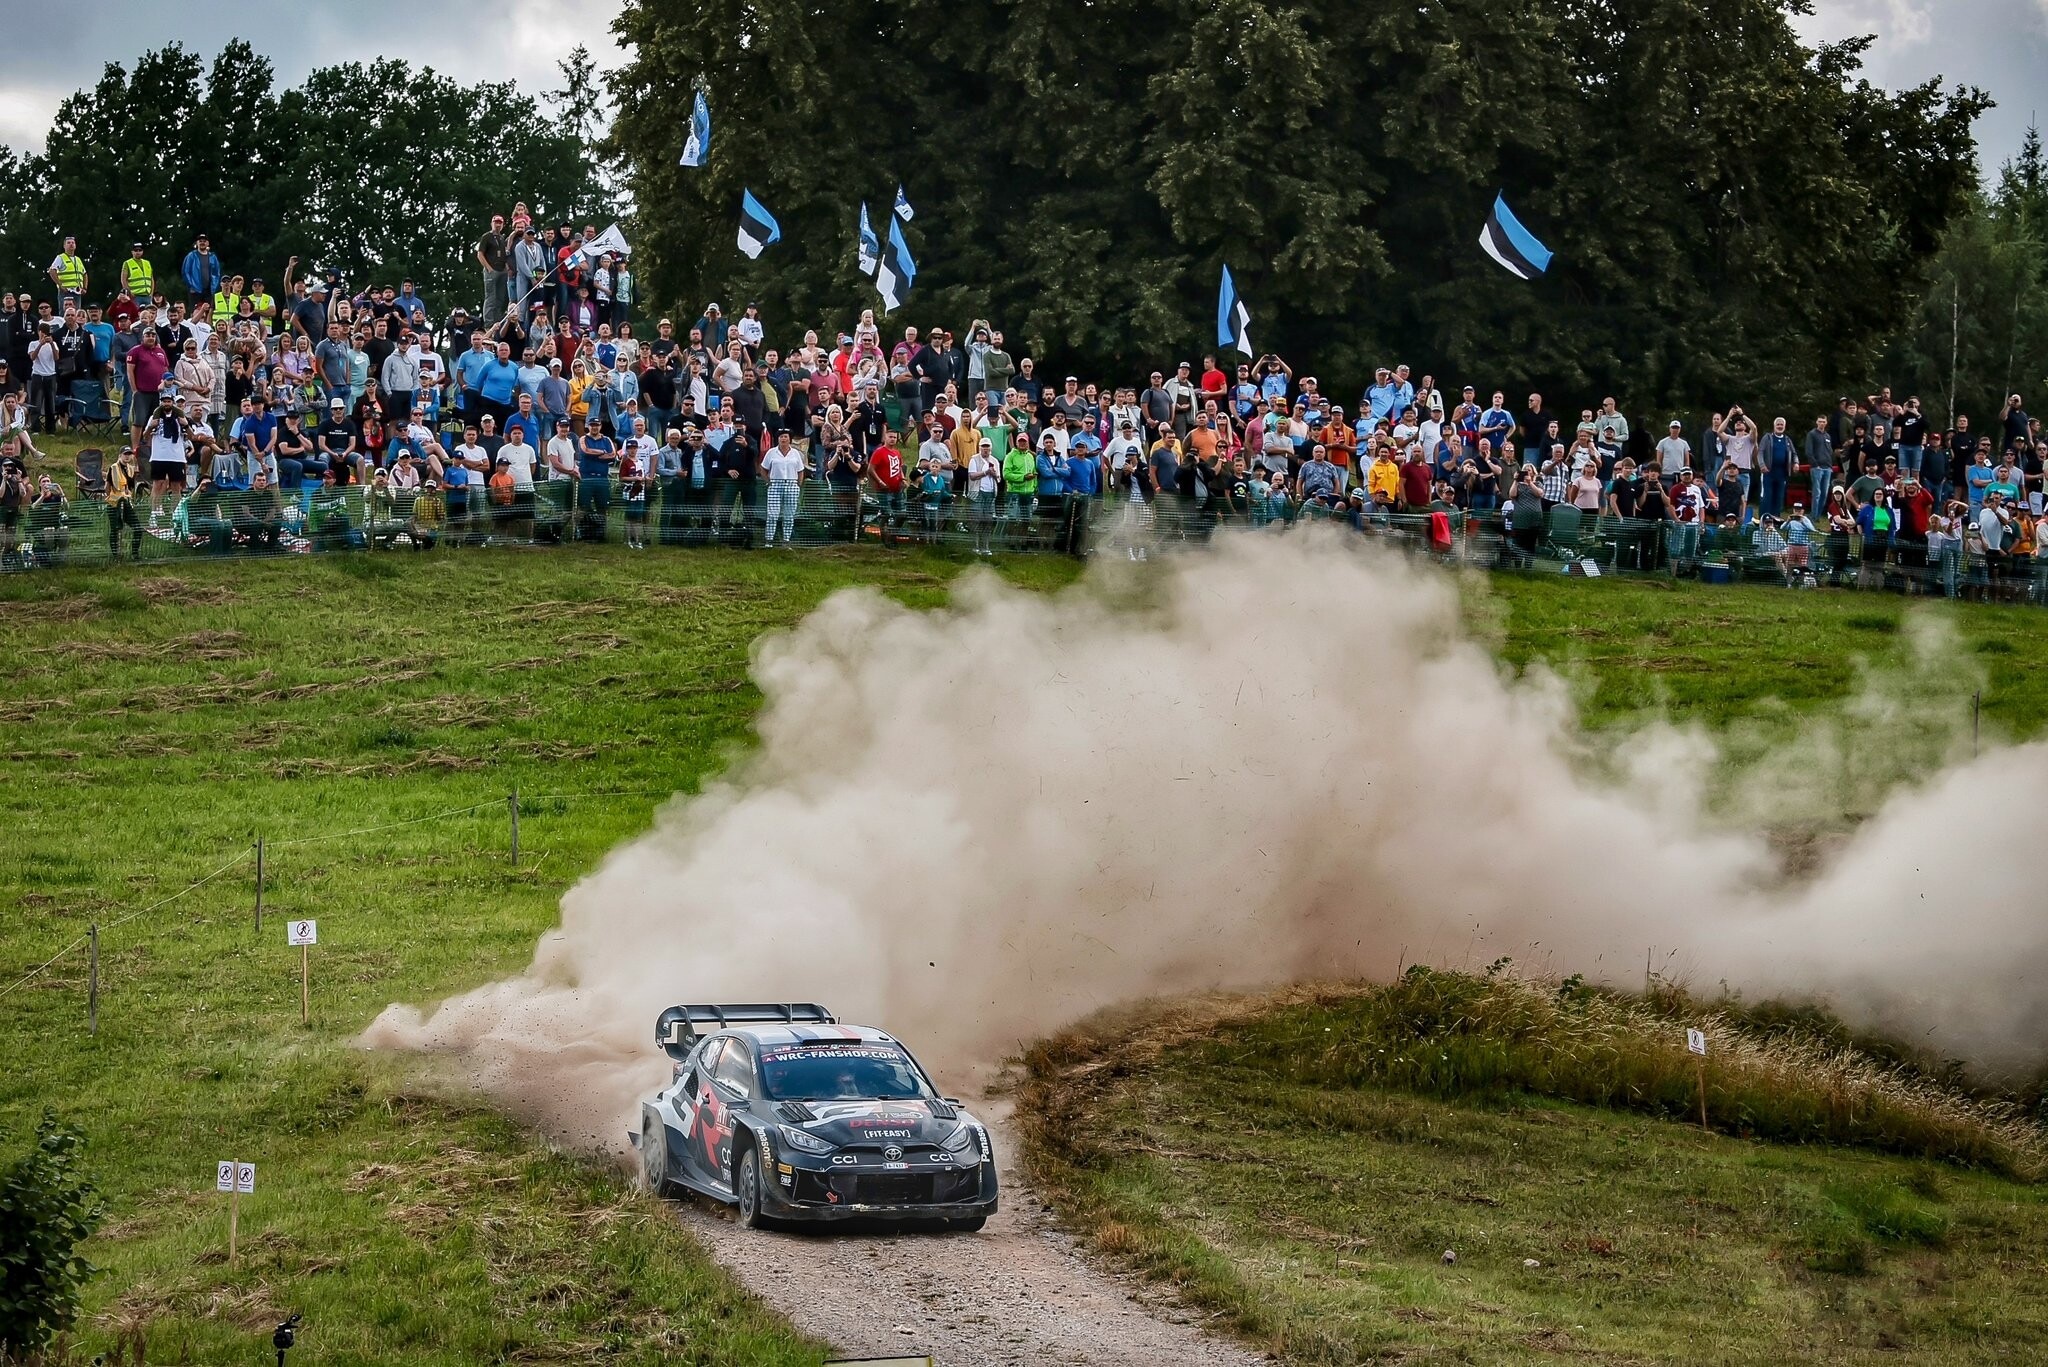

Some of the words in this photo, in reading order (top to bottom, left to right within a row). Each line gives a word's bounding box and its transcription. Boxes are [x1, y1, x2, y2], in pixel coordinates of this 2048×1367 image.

[775, 1049, 900, 1062] WRC-FANSHOP.COM
[849, 1118, 915, 1128] DENSO
[832, 1155, 858, 1164] CCI
[929, 1153, 954, 1162] CCI
